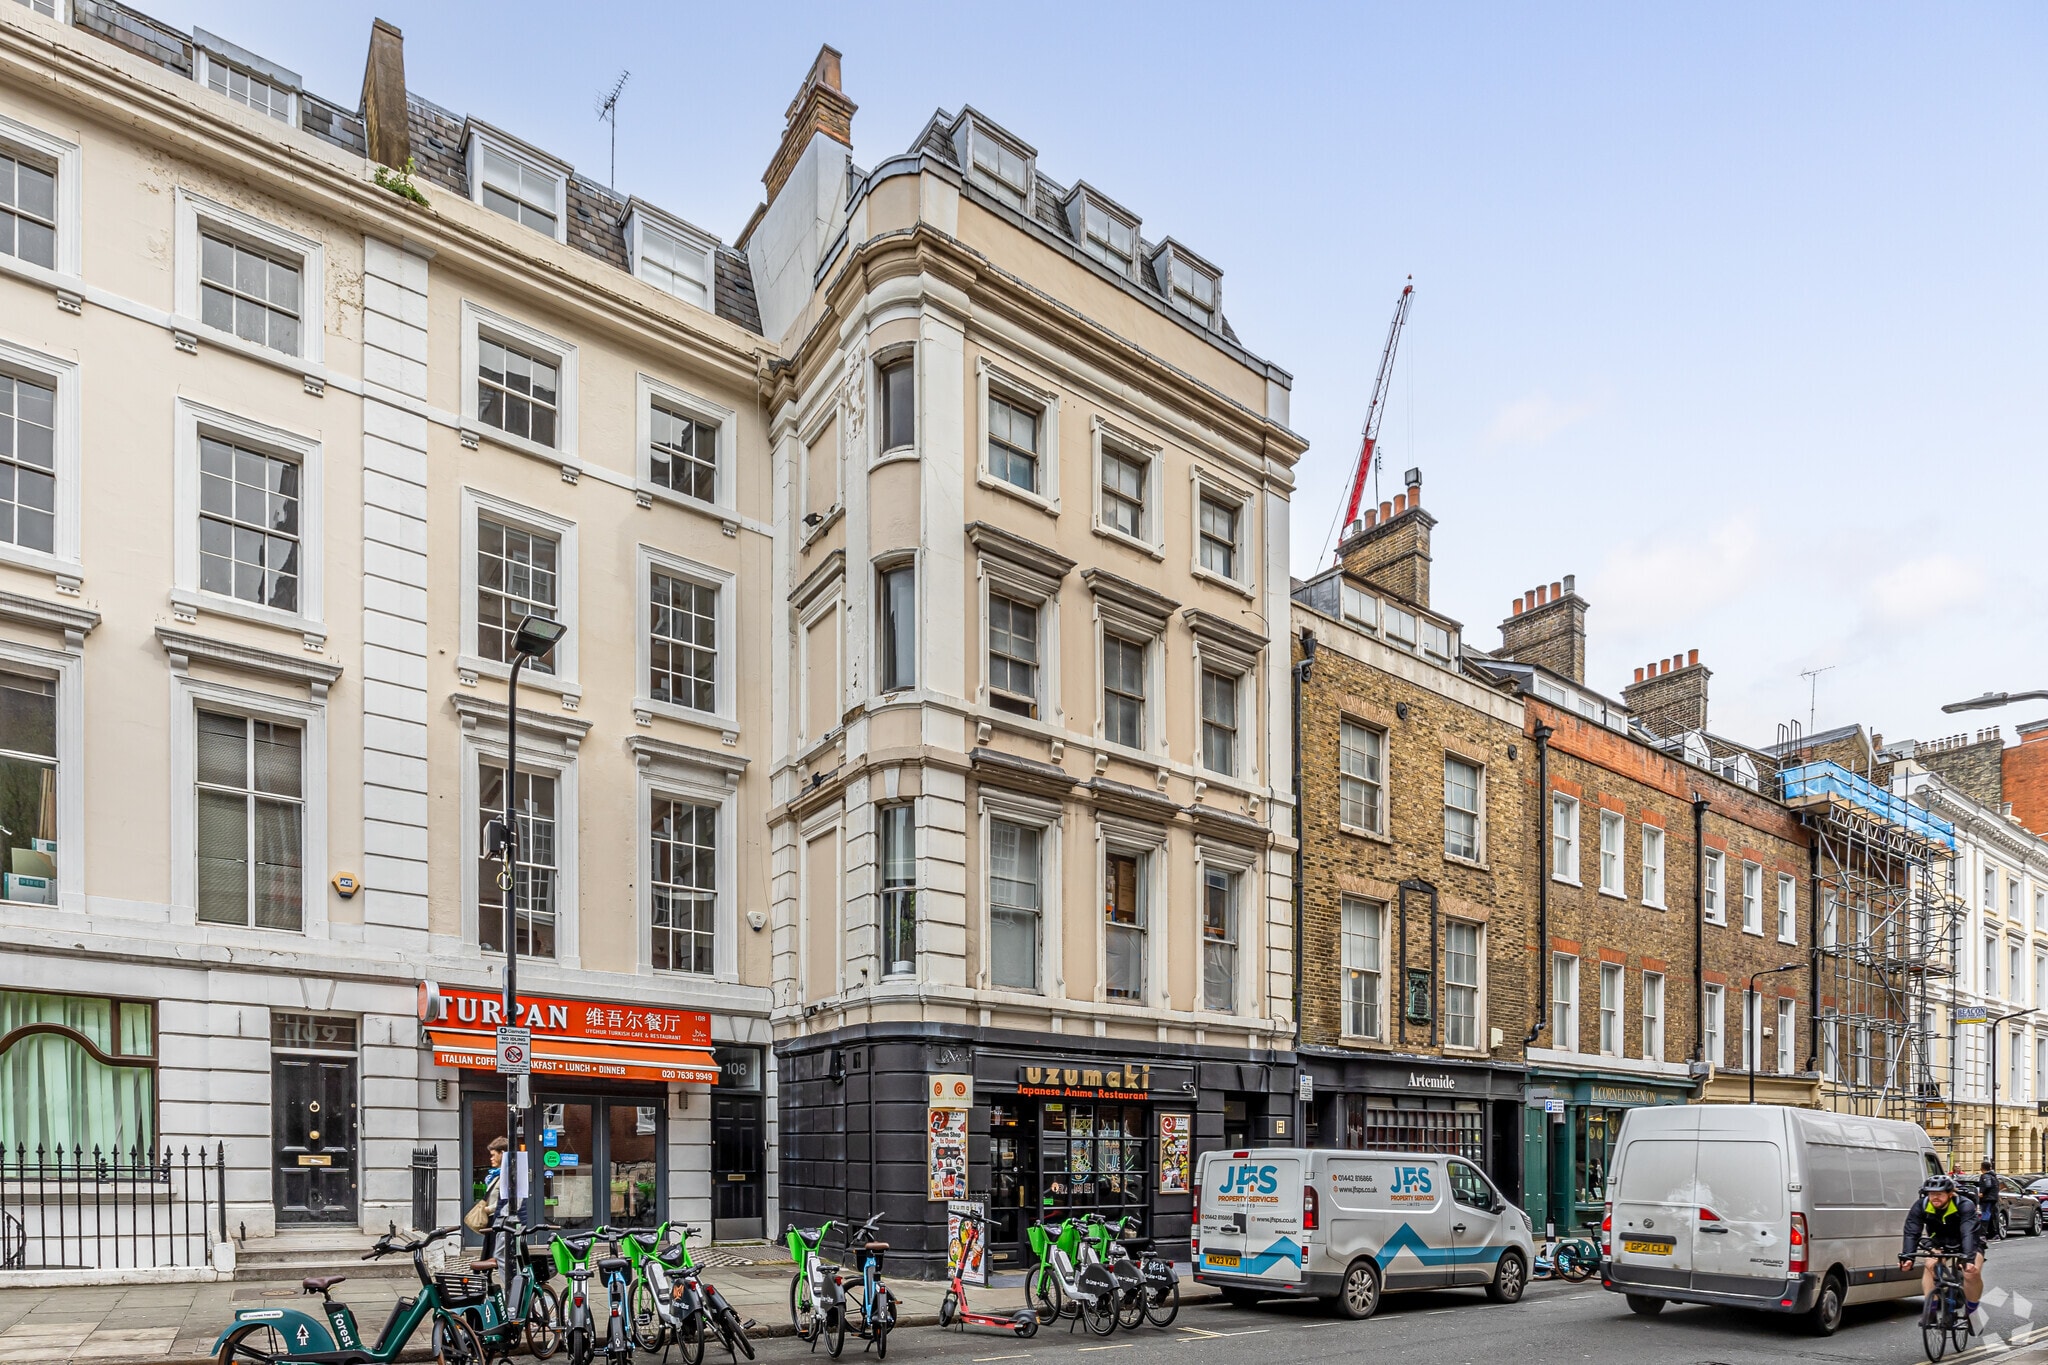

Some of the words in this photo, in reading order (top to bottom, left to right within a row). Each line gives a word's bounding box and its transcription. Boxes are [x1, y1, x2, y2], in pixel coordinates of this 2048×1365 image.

[1957, 1007, 1986, 1015] BEACON
[585, 1007, 681, 1032] 维吾尔餐厅
[650, 1033, 682, 1041] RESTAURANT
[441, 1054, 473, 1064] ITALIAN
[475, 1056, 497, 1066] COFF
[530, 1060, 557, 1070] AKFAST
[565, 1062, 590, 1073] LUNCH
[598, 1065, 626, 1075] DINNER
[725, 1062, 747, 1076] 108
[662, 1070, 676, 1079] 020
[677, 1071, 694, 1079] 7636
[695, 1072, 713, 1081] 9949
[1026, 1064, 1150, 1089] uzumaki
[1408, 1072, 1455, 1090] Artemide
[1017, 1084, 1060, 1097] Japanese
[1064, 1086, 1093, 1098] Anime
[1098, 1089, 1149, 1100] Restaurant
[1598, 1086, 1646, 1103] CORNELISSEN
[1547, 1101, 1552, 1110] P
[1218, 1164, 1279, 1194] JFS
[1337, 1174, 1354, 1182] 01442
[1390, 1166, 1433, 1194] JFS
[1338, 1186, 1378, 1194] www.jfsps.co.uk
[1631, 1243, 1650, 1251] GP21
[1208, 1256, 1224, 1264] WN23
[496, 1292, 508, 1321] forest
[333, 1312, 354, 1347] forest
